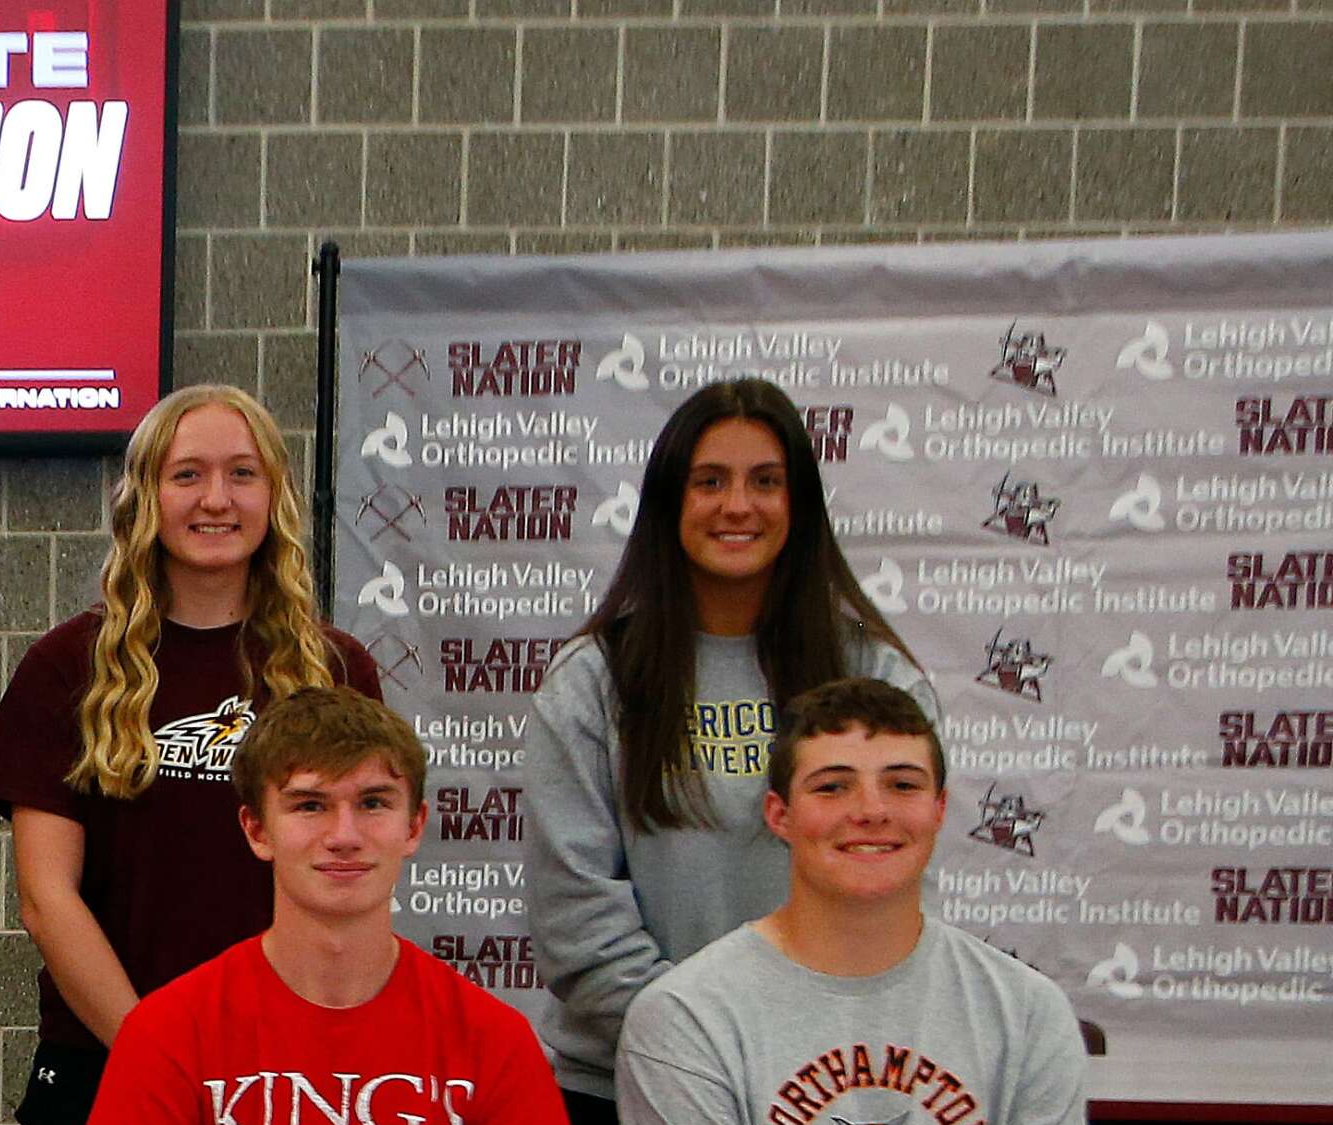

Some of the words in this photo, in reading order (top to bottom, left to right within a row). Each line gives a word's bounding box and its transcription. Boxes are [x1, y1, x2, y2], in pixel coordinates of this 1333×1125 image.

[660, 333, 752, 363] Lehigh
[758, 334, 841, 362] Valley
[1185, 319, 1284, 354] Lehigh
[448, 341, 581, 367] SLATER
[453, 367, 576, 397] NATION
[833, 360, 949, 386] Institute
[422, 411, 511, 441] Lehigh
[517, 412, 597, 440] Valley
[926, 403, 1023, 433] Lehigh
[1028, 403, 1114, 431] Valley
[422, 440, 577, 470] Orthopedic
[924, 431, 1091, 465] Orthopedic
[1103, 428, 1224, 456] Institute
[445, 487, 577, 512] SLATER
[1177, 472, 1277, 505] Lehigh
[448, 513, 571, 542] NATION
[418, 562, 507, 590] Lehigh
[513, 562, 594, 592] Valley
[918, 558, 1016, 589] Lehigh
[1021, 559, 1107, 587] Valley
[418, 591, 574, 620] Orthopedic
[918, 588, 1084, 618] Orthopedic
[1094, 586, 1216, 614] Institute
[1170, 632, 1266, 662] Lehigh
[415, 715, 504, 740] Lehigh
[1015, 715, 1098, 743] Valley
[950, 745, 1075, 772] thopedic
[1087, 745, 1207, 770] Institute
[159, 768, 192, 780] FIELD
[198, 773, 230, 782] HOCK
[438, 788, 523, 814] SLAT
[1161, 790, 1259, 820] Lehigh
[440, 814, 523, 841] NATI
[410, 864, 499, 892] Lehigh
[1007, 870, 1091, 898] Valley
[410, 890, 524, 918] Orthope
[943, 899, 1070, 927] thopedic
[1080, 898, 1200, 924] Institute
[1153, 946, 1251, 976] Lehigh
[1153, 975, 1324, 1004] Orthopedic
